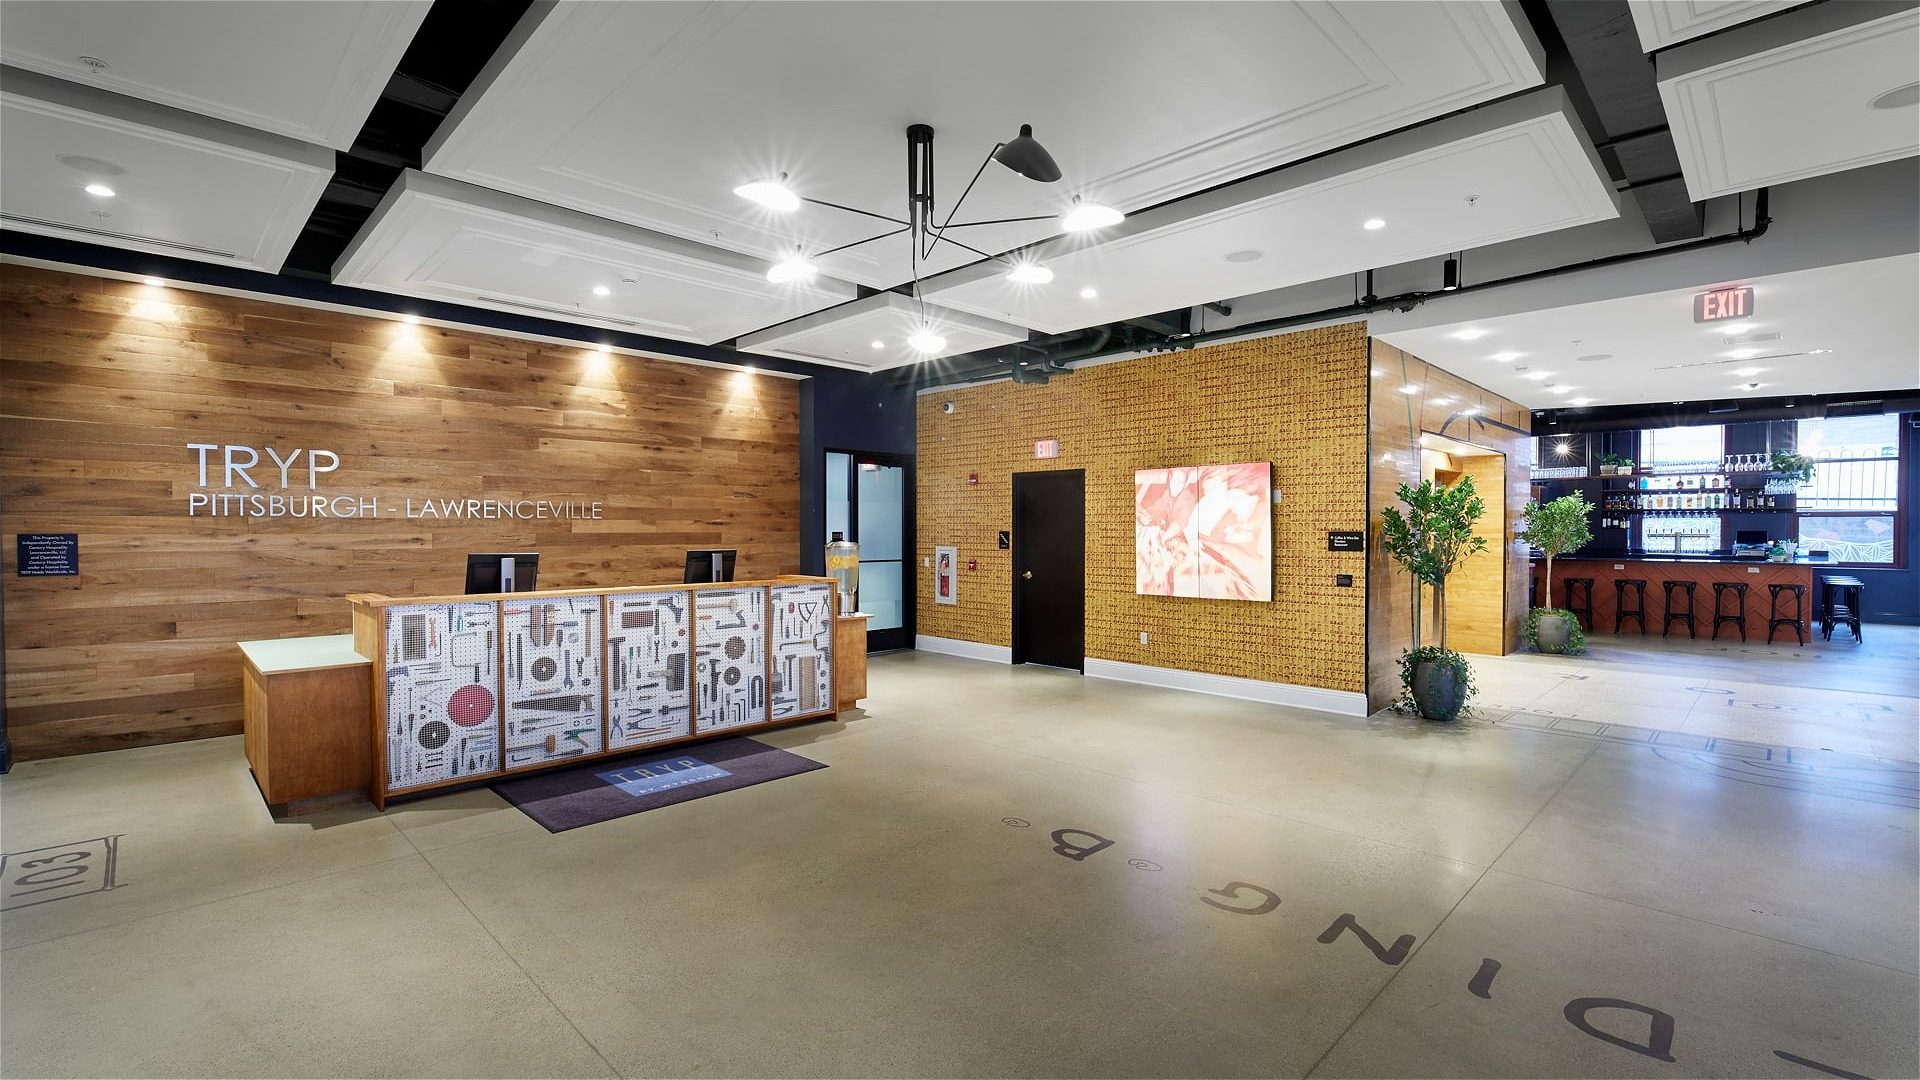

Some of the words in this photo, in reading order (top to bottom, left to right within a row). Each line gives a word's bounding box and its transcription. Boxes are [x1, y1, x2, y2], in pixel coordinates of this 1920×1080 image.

[1703, 289, 1746, 320] EXIT
[1038, 440, 1053, 458] EXIT
[187, 443, 340, 490] TRYP
[189, 493, 377, 517] PITTSBURGH
[406, 498, 603, 520] LAWRENCEVILLE
[610, 760, 697, 783] TRYP
